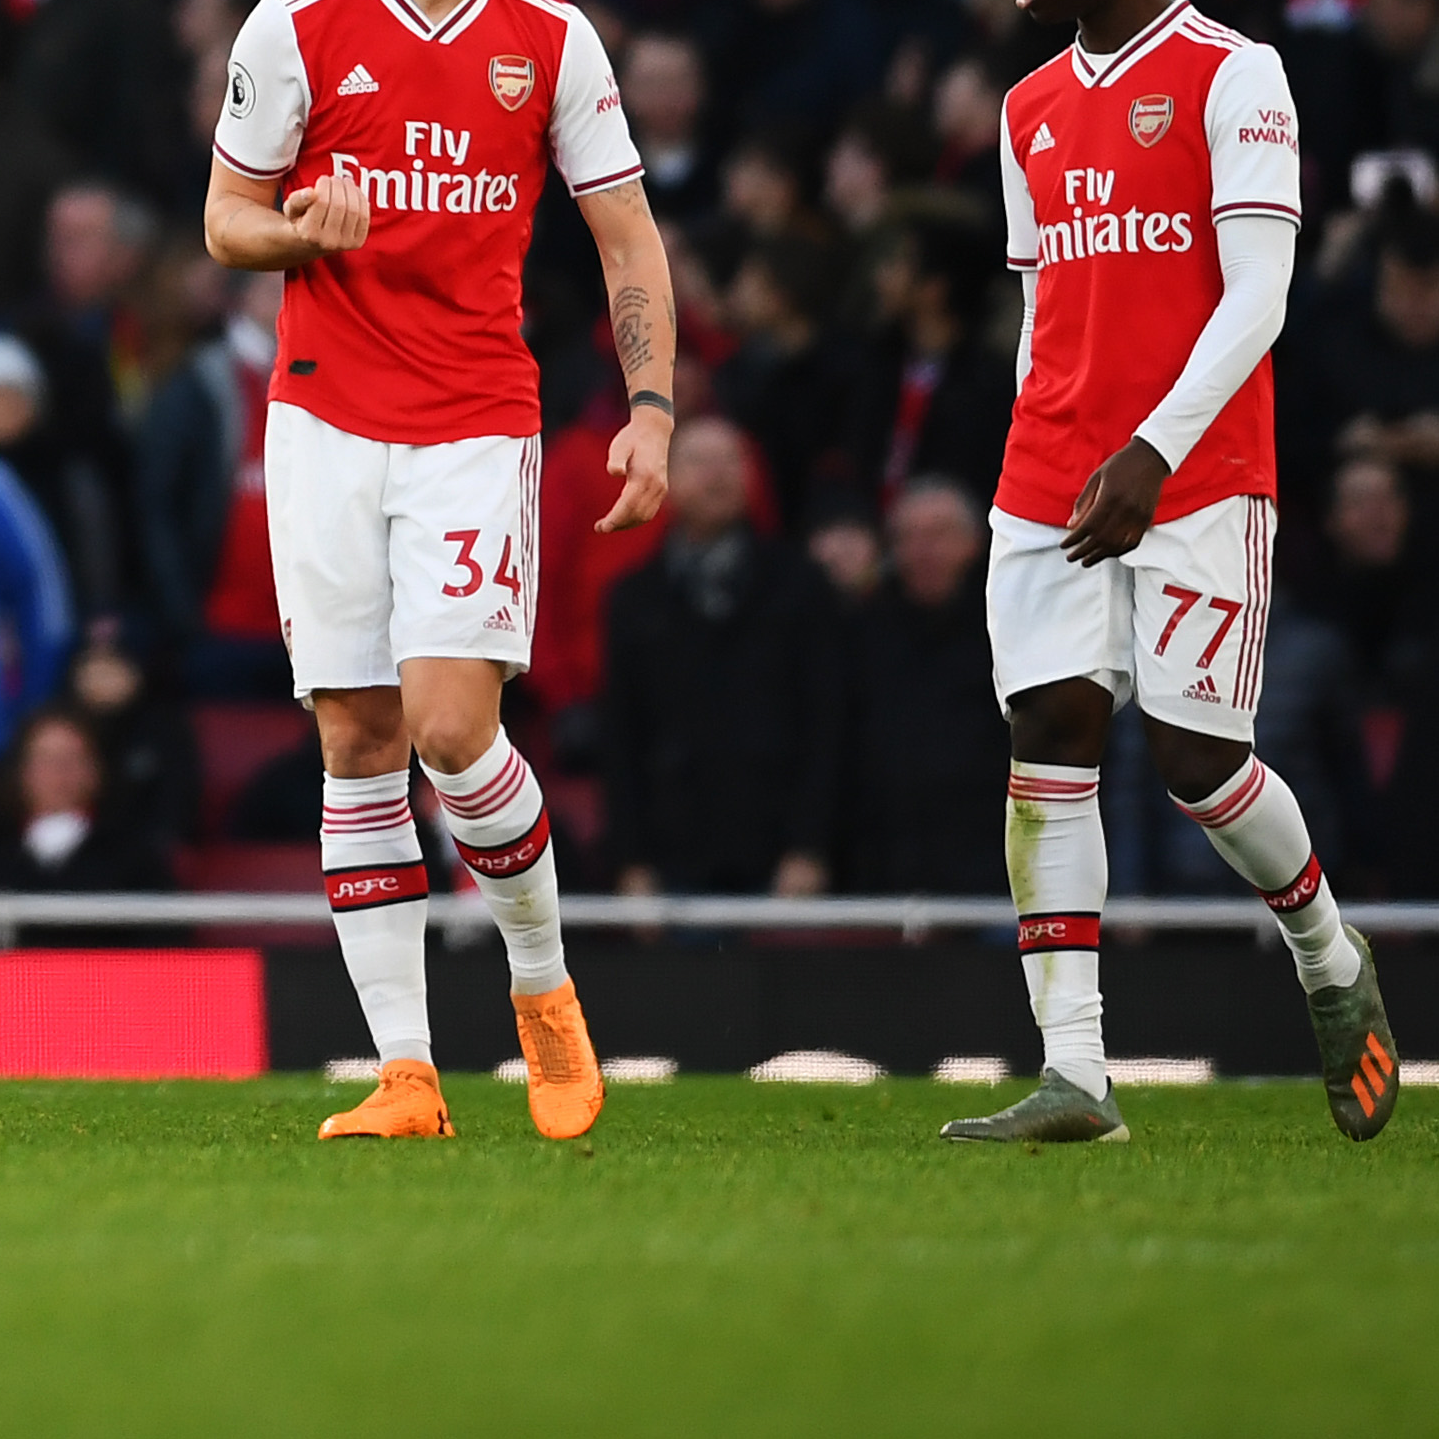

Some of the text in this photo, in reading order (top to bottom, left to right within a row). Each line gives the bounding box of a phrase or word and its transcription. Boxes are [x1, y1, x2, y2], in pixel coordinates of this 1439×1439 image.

[337, 81, 380, 96] adidas
[405, 121, 470, 165] Fly
[1064, 168, 1115, 206] Fly
[1037, 206, 1193, 271] mirates
[441, 528, 521, 606] 34
[1154, 583, 1244, 669] 77
[1182, 689, 1222, 704] adidas
